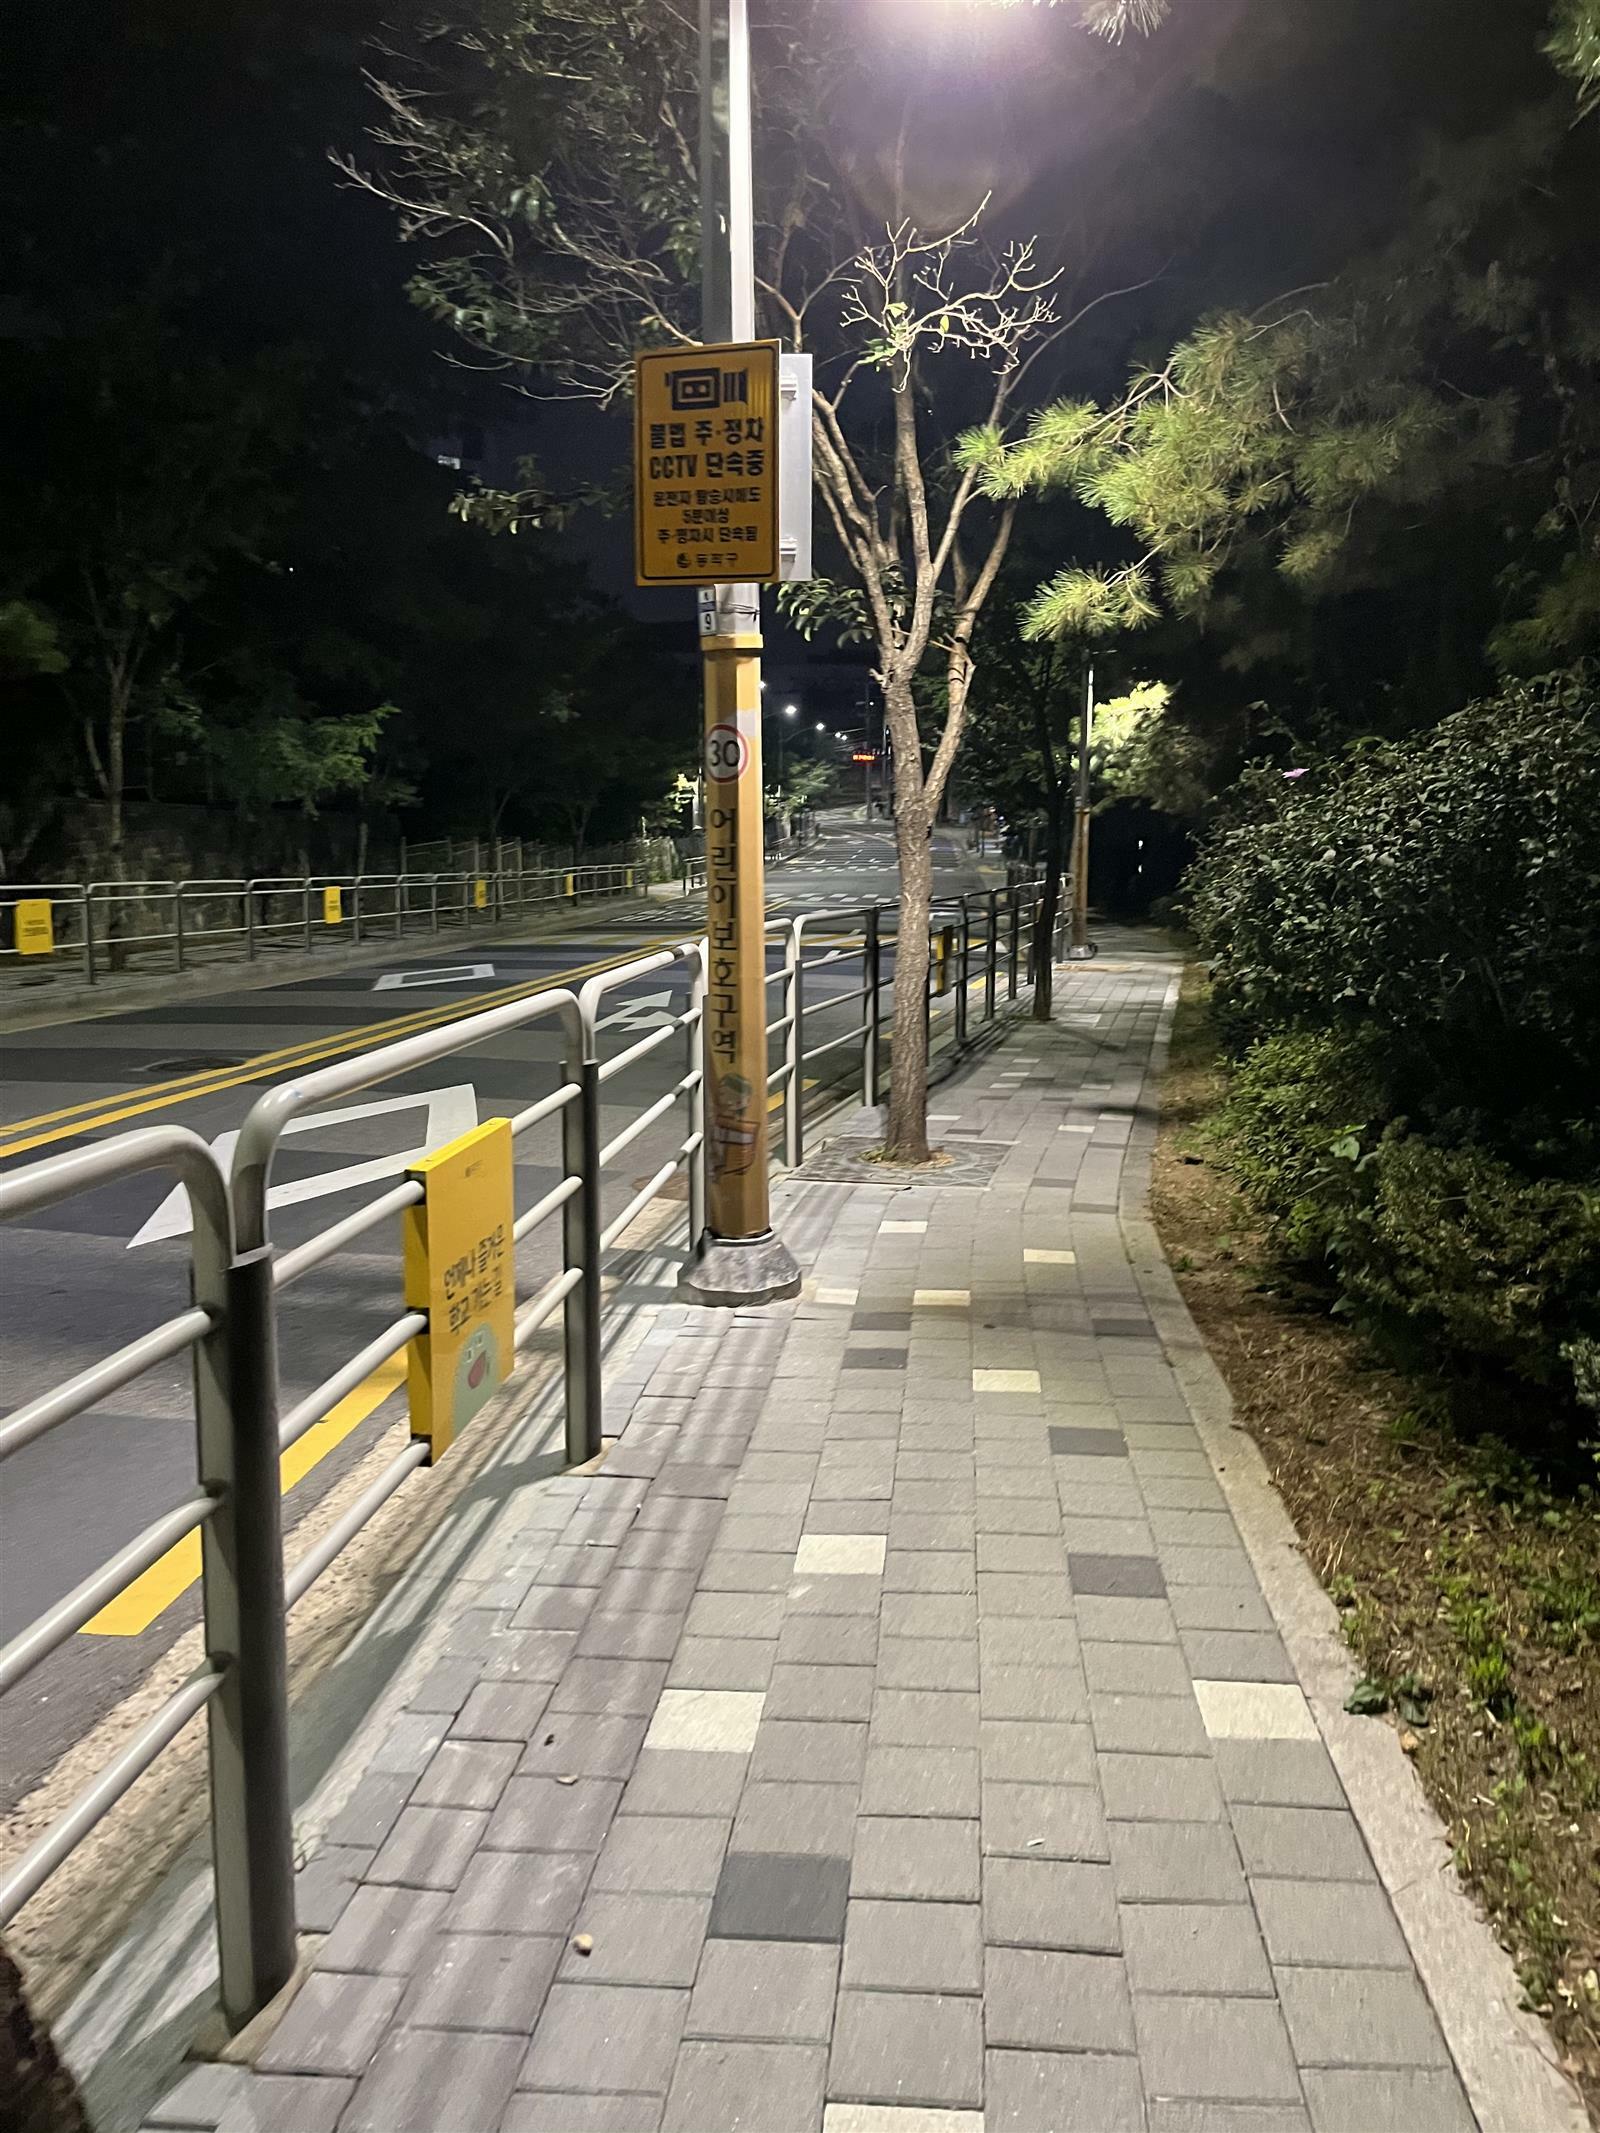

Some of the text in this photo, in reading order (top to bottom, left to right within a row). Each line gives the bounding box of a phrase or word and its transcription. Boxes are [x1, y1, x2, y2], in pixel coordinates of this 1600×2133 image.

[650, 423, 686, 449] 불법
[650, 450, 764, 480] CCTV 단속중
[711, 739, 741, 768] 30
[711, 807, 738, 1064] 어린이보호구역
